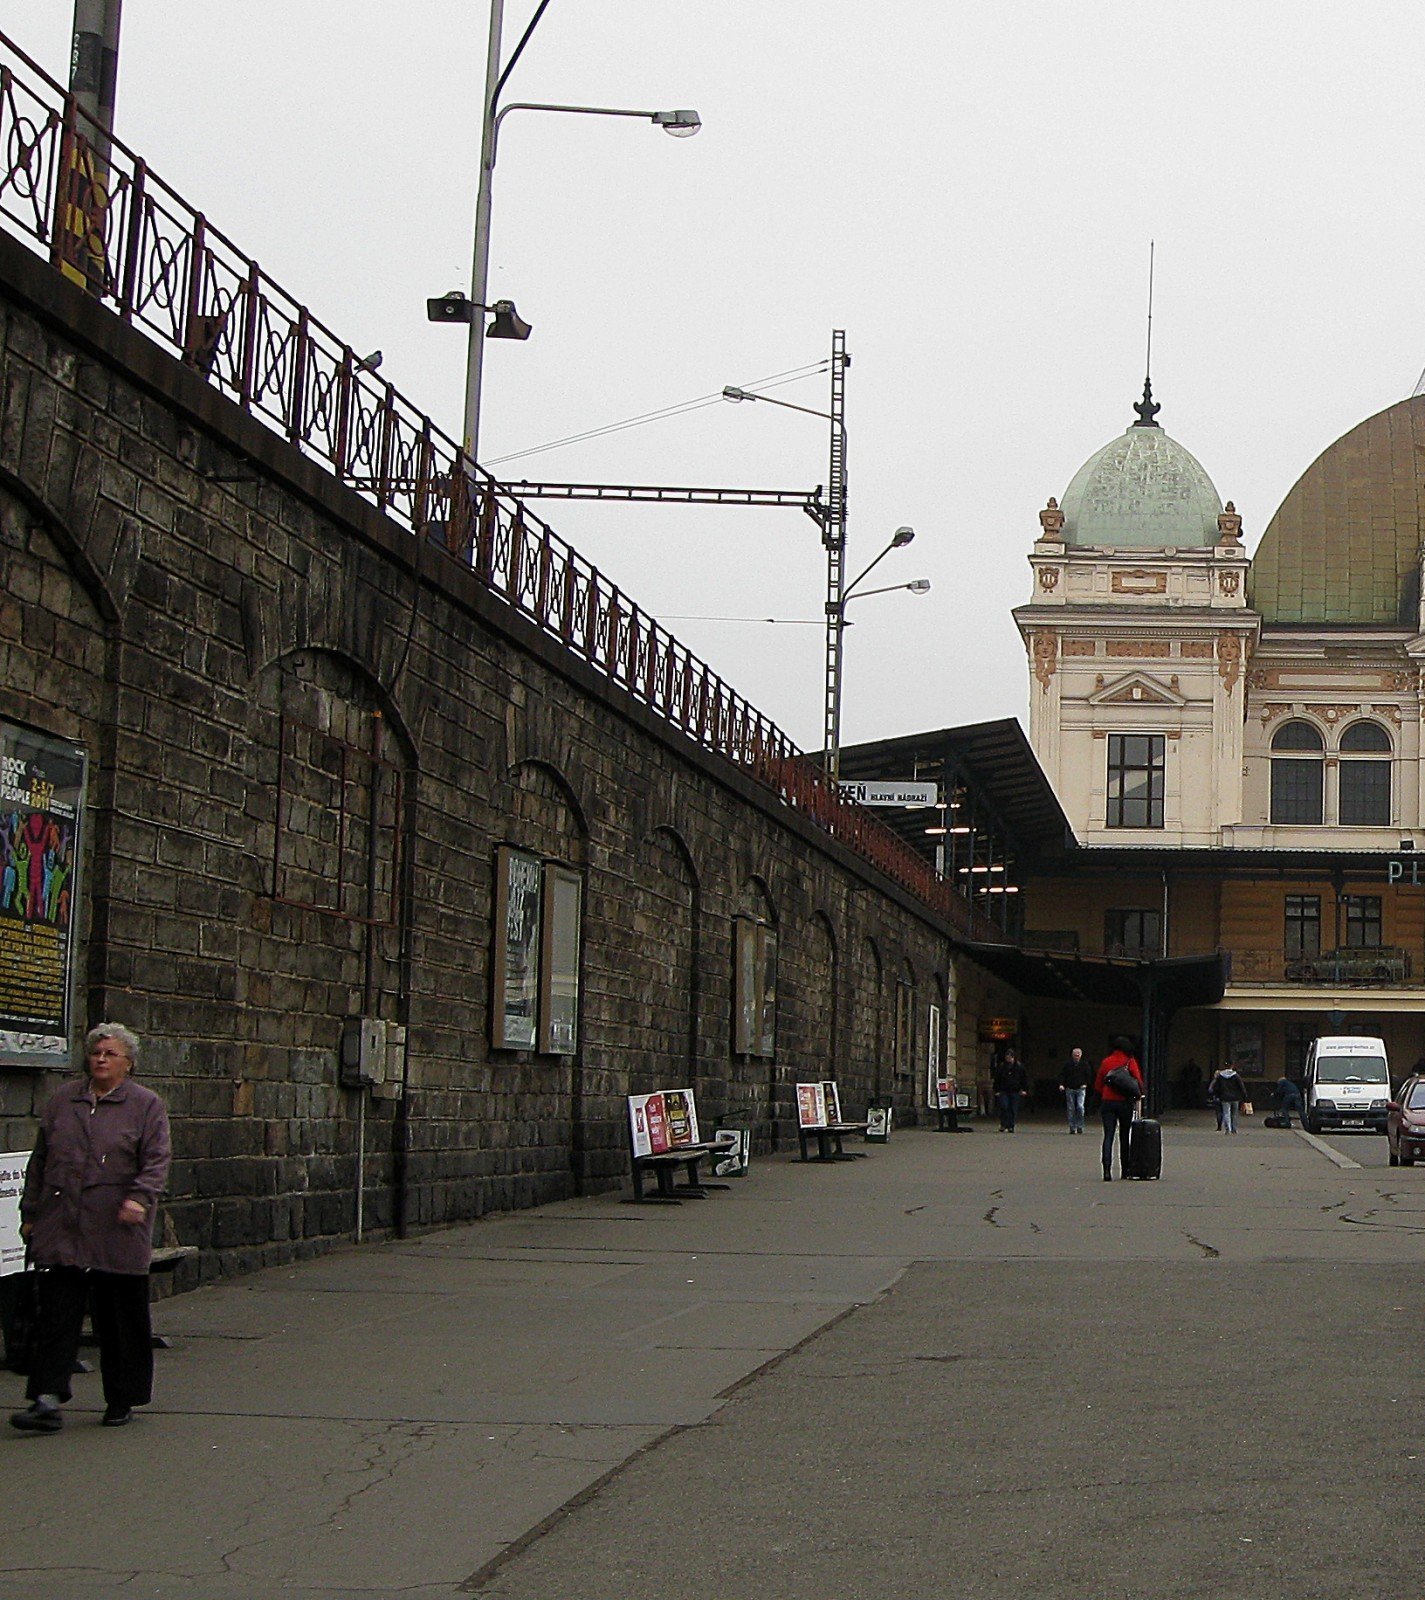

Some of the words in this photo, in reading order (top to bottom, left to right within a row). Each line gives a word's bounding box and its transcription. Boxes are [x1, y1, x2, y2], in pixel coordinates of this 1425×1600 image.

[2, 755, 27, 775] ROCK
[1, 770, 19, 787] FOR
[0, 784, 31, 805] PEOPLE
